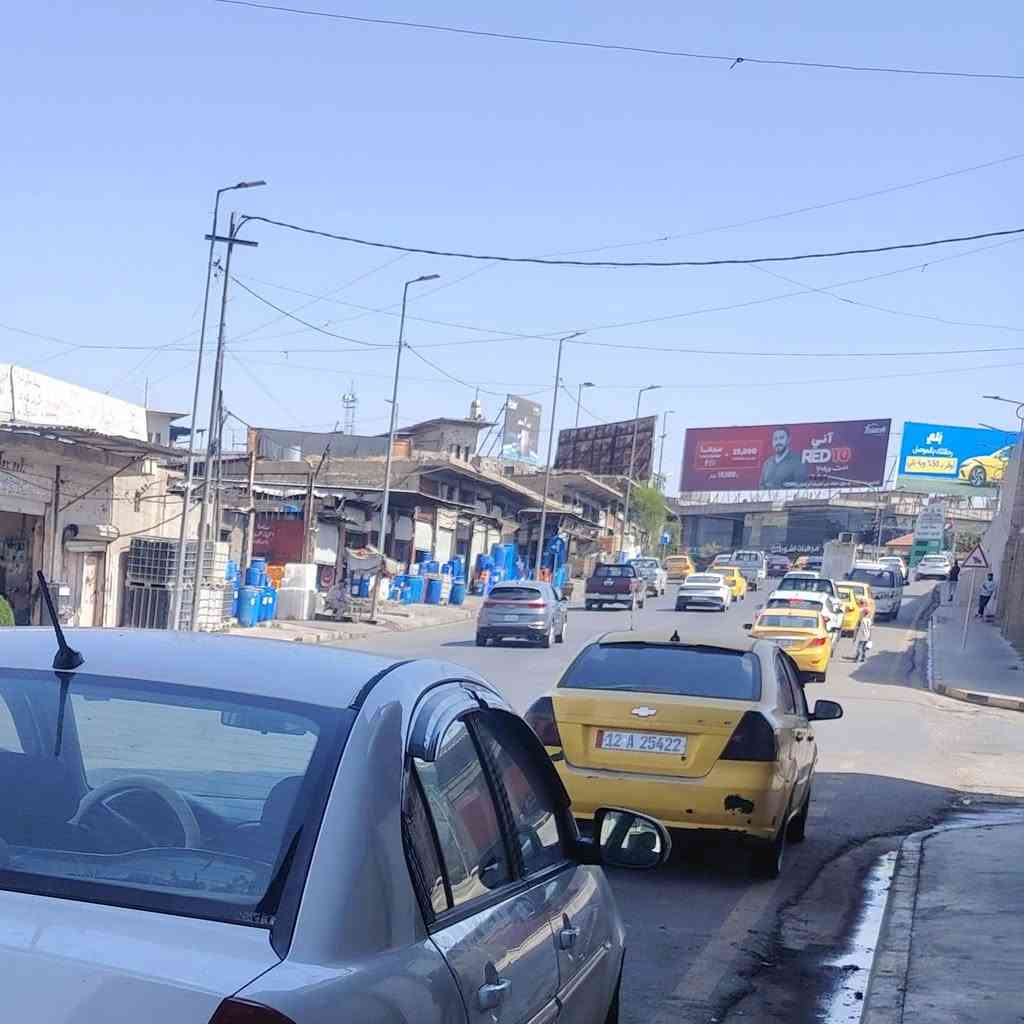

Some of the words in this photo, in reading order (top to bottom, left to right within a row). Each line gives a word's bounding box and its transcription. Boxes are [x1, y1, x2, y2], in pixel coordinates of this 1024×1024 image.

[605, 733, 623, 747] 12
[626, 734, 634, 748] A
[639, 735, 681, 752] 25422
